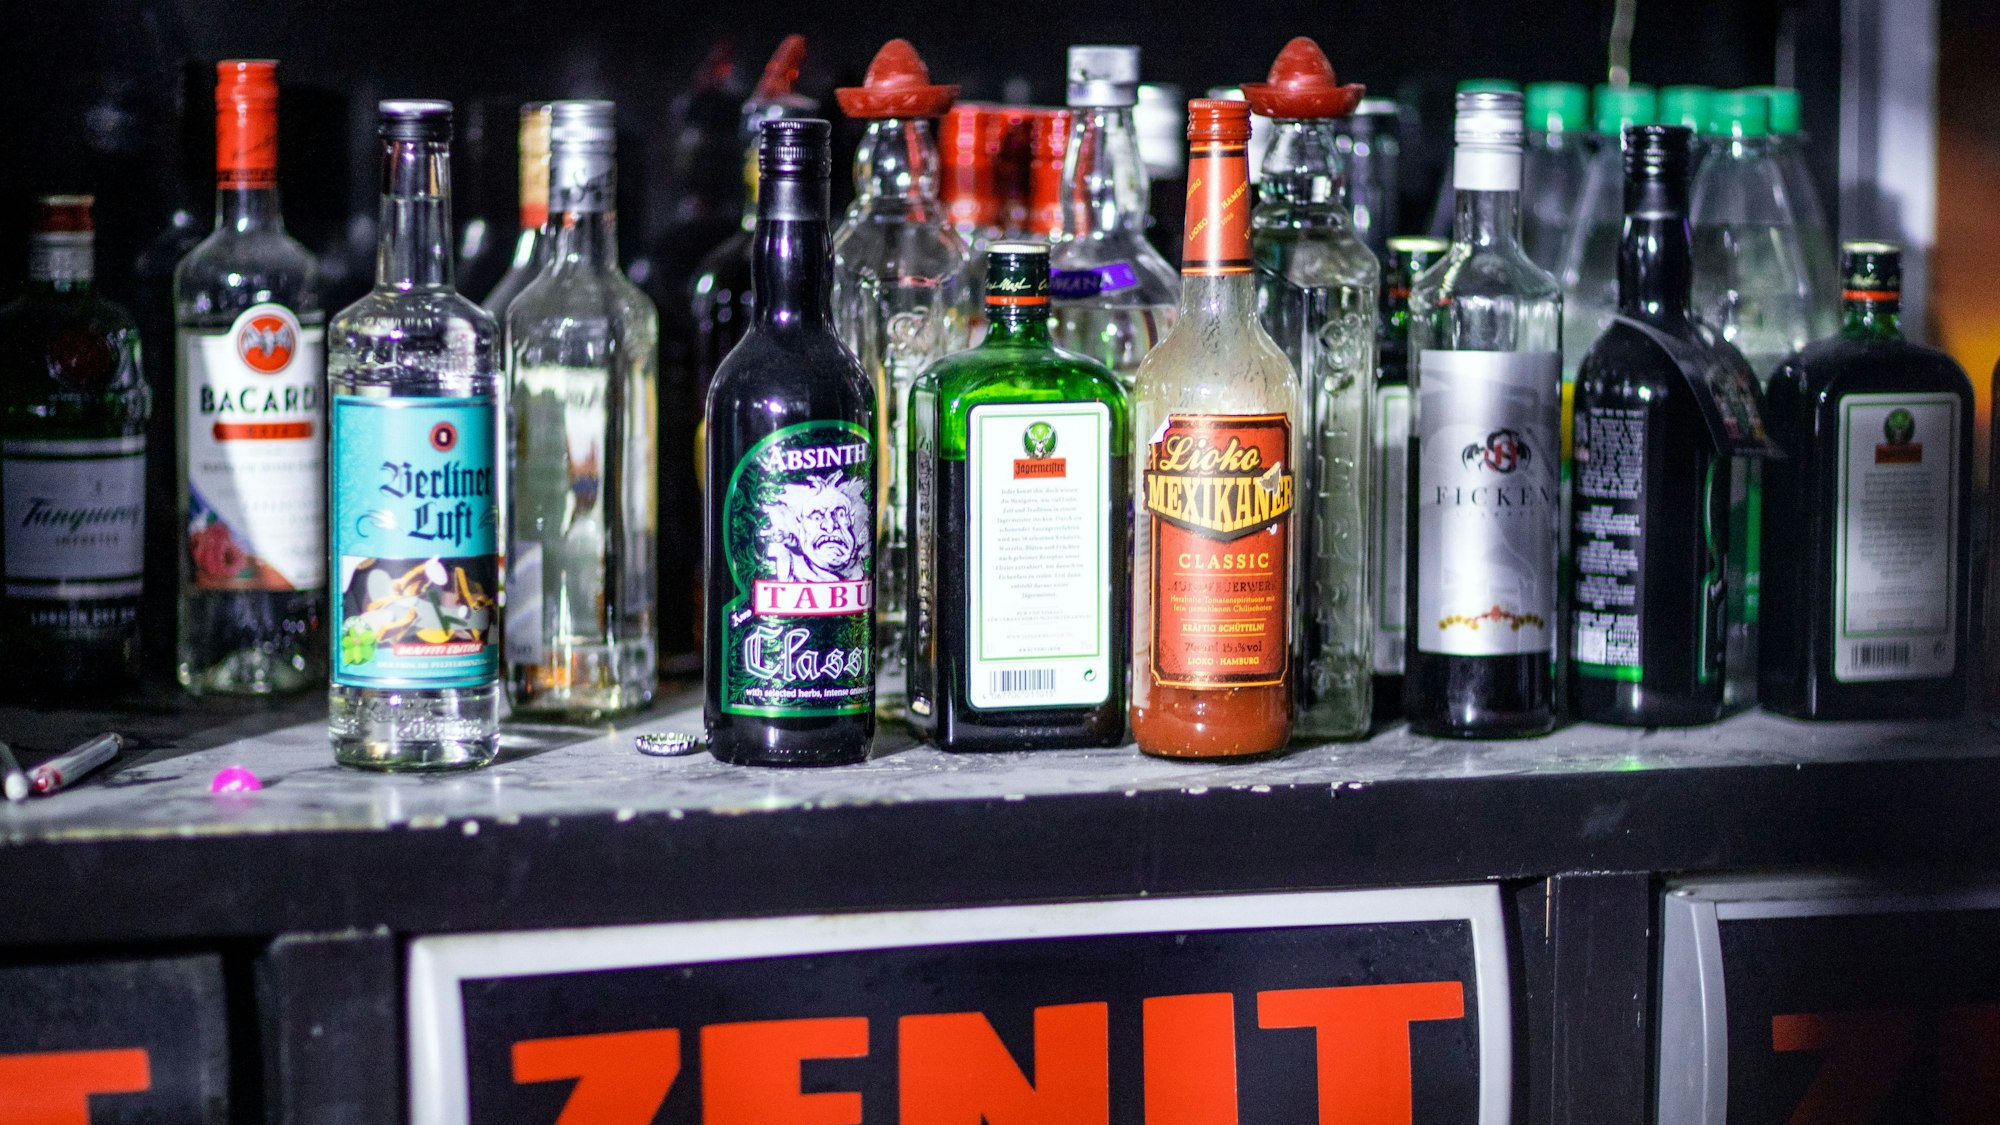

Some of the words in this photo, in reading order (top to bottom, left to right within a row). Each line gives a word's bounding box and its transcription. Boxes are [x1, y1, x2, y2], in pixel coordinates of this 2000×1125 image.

[1188, 218, 1208, 242] LIOKO
[1220, 180, 1248, 209] HAMBUR
[201, 386, 315, 414] BACARD
[765, 442, 867, 471] ABSINTH
[1160, 435, 1260, 471] Lioko
[379, 461, 491, 498] Berliner
[1015, 461, 1064, 478] Jägermeister
[1147, 474, 1293, 533] MEXIKANER
[408, 501, 473, 548] Luft
[1179, 553, 1270, 569] CLASSIC
[763, 585, 869, 608] TABU
[1266, 595, 1276, 603] mit
[1186, 657, 1214, 666] LIOKO
[1218, 656, 1260, 666] HAMBURG
[745, 688, 763, 698] with
[764, 688, 797, 698] selected
[797, 688, 822, 699] herbs,
[823, 688, 849, 698] intense
[512, 981, 1465, 1125] ZENIT
